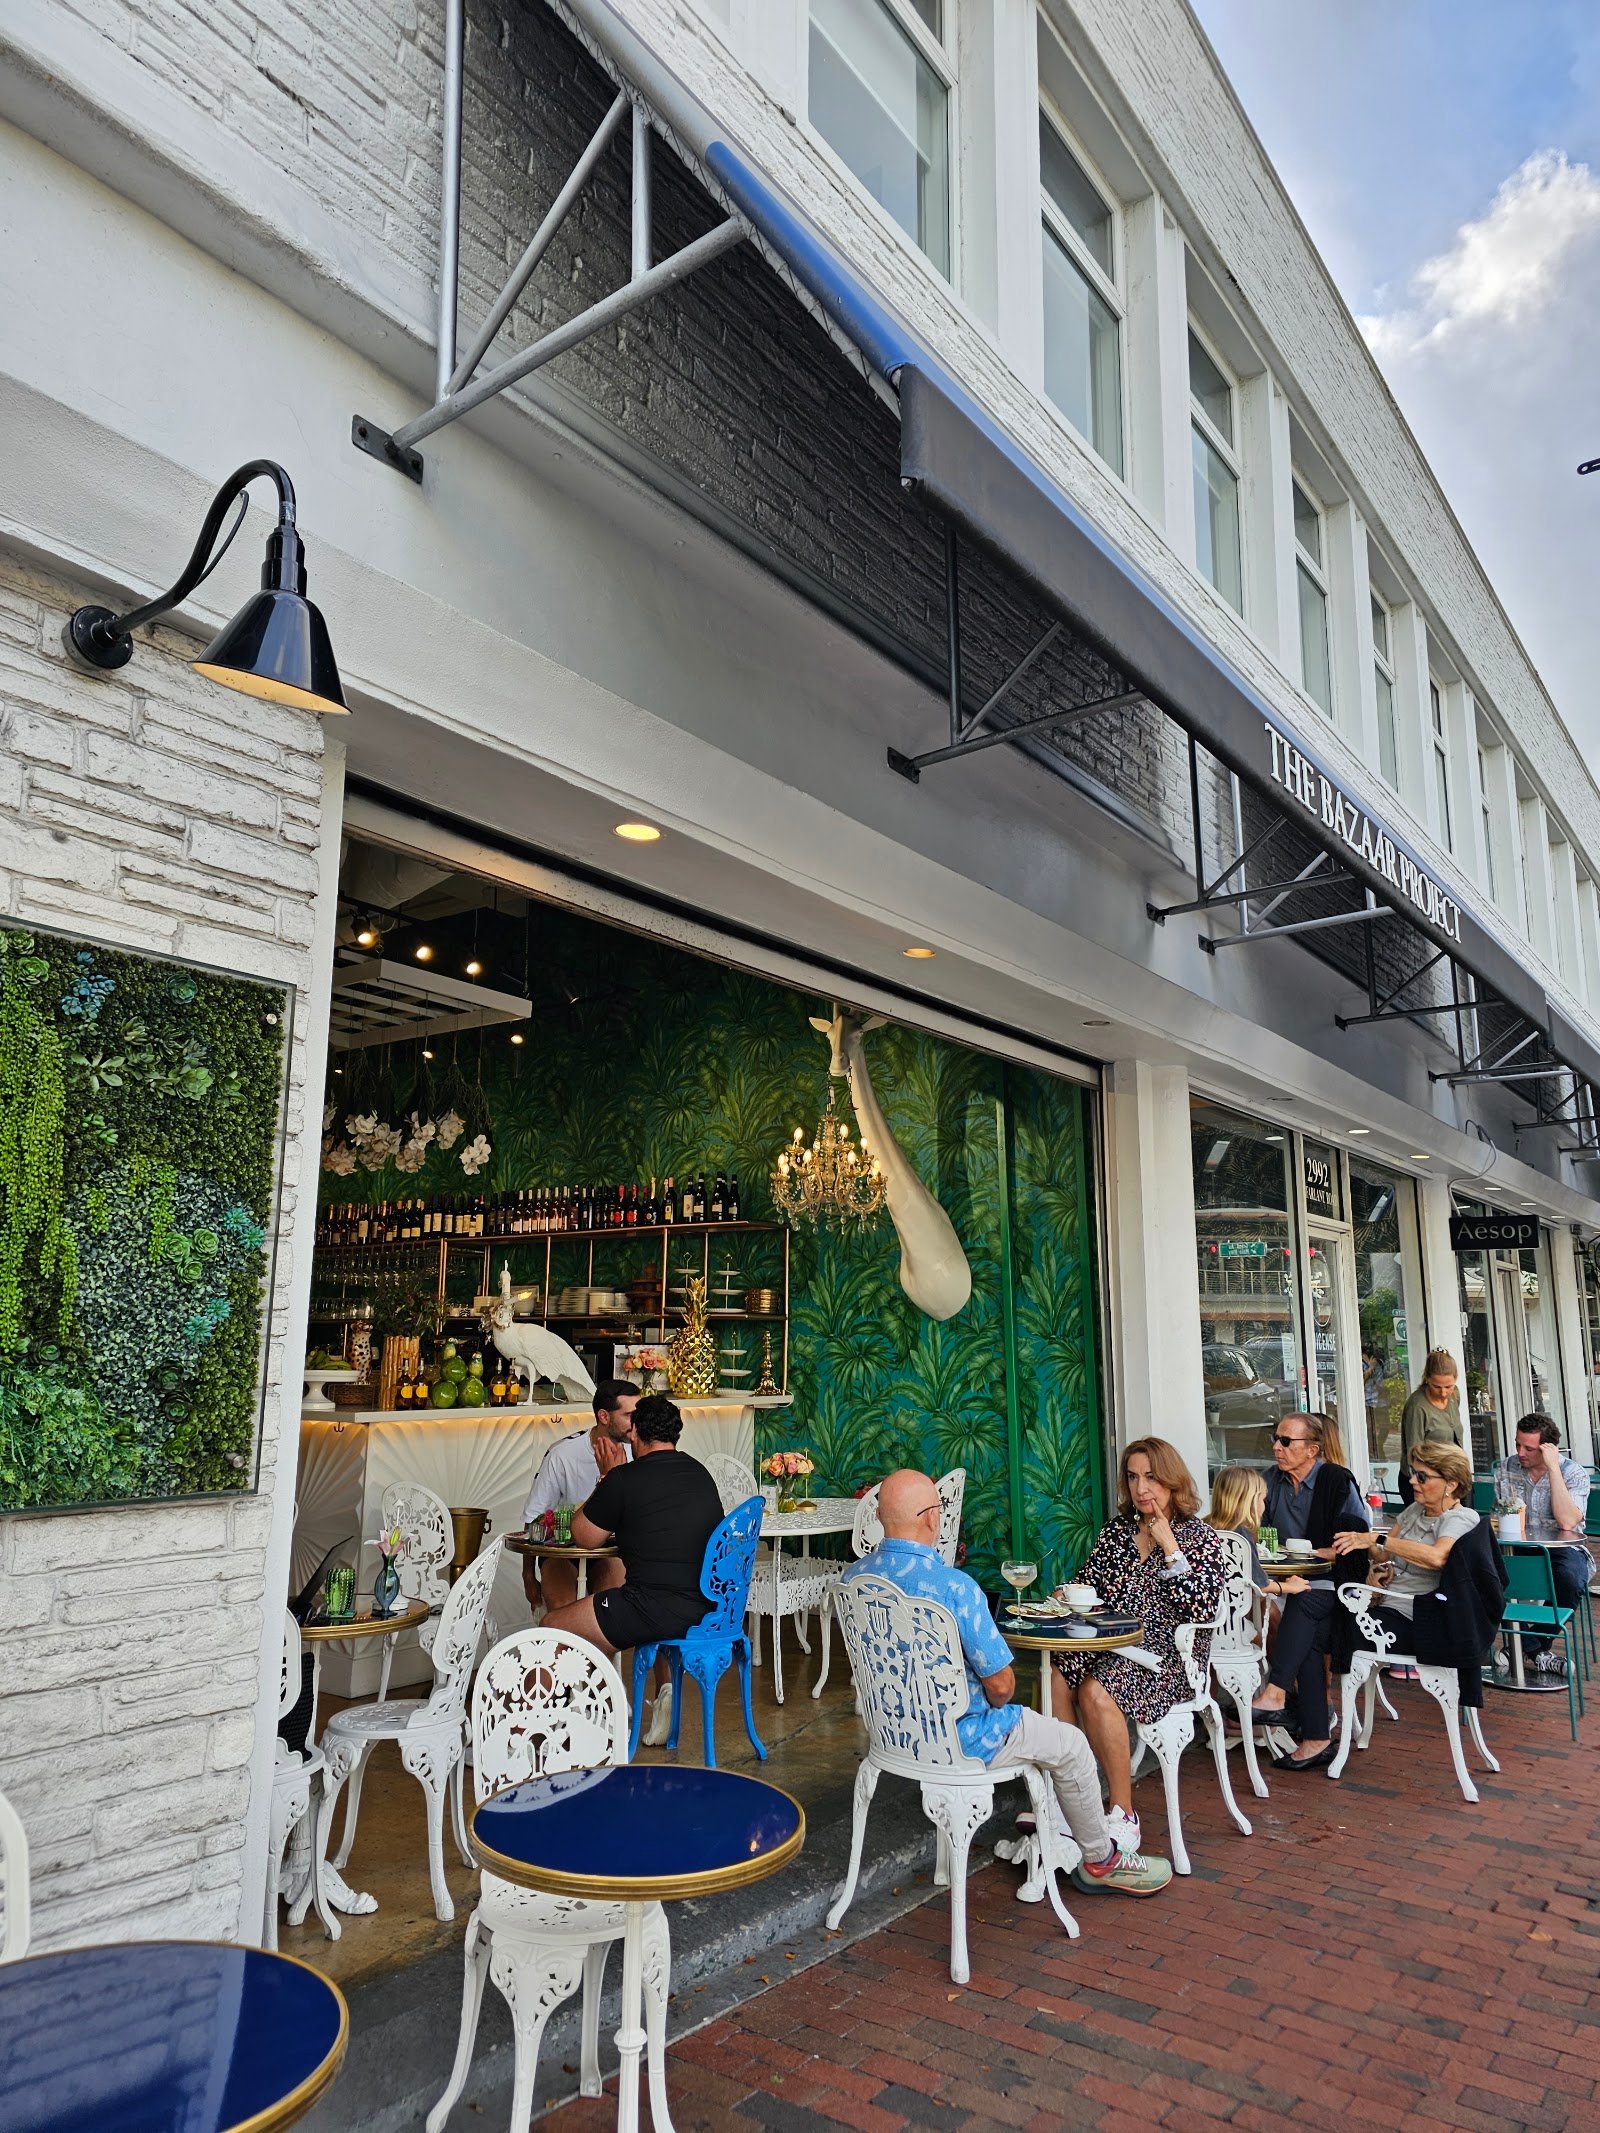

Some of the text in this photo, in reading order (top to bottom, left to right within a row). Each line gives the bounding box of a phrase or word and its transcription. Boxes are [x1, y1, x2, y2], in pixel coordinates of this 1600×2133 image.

[1265, 722, 1461, 944] THE BAZAAR PROJECT
[1306, 1157, 1329, 1187] 2992
[1456, 1222, 1533, 1244] Aēsop
